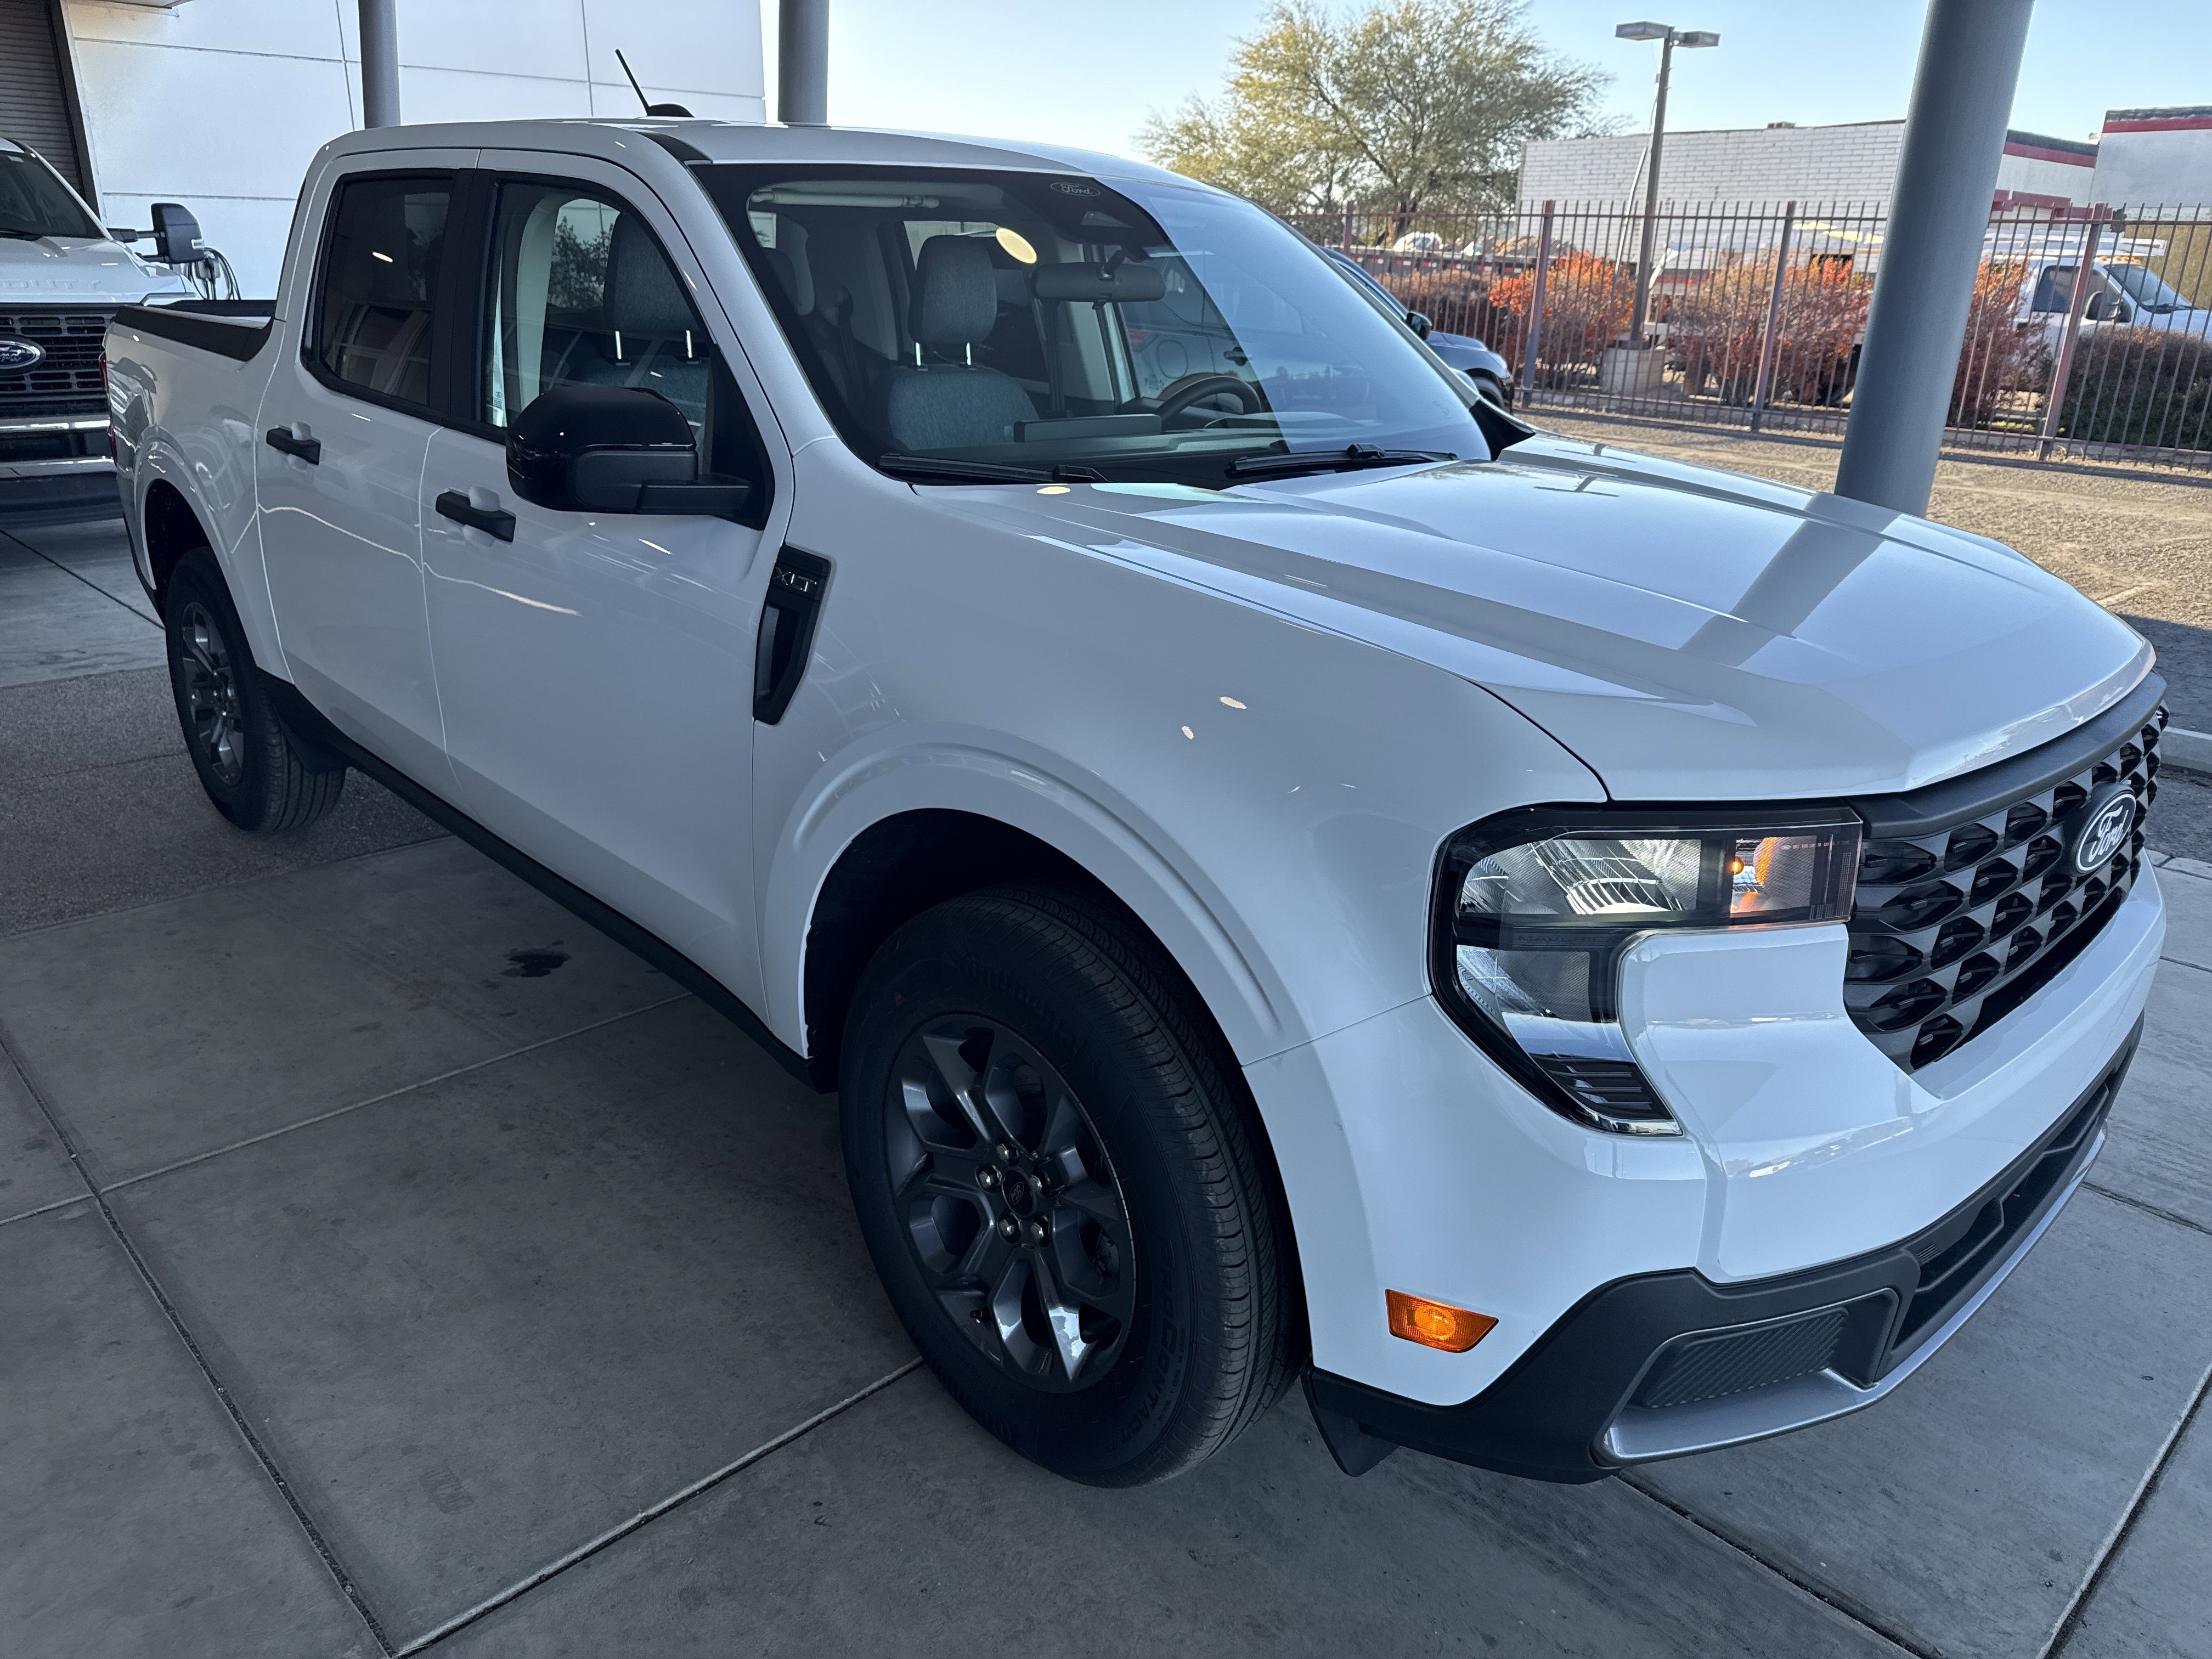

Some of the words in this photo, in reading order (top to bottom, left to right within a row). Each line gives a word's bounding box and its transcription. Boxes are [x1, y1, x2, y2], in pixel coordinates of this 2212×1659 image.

[1060, 183, 1093, 195] Ford
[3, 279, 101, 290] DUTY
[771, 567, 817, 592] XLT
[2088, 805, 2129, 862] Ford
[1518, 935, 1616, 943] MAVERICK
[958, 952, 1090, 1063] Continental
